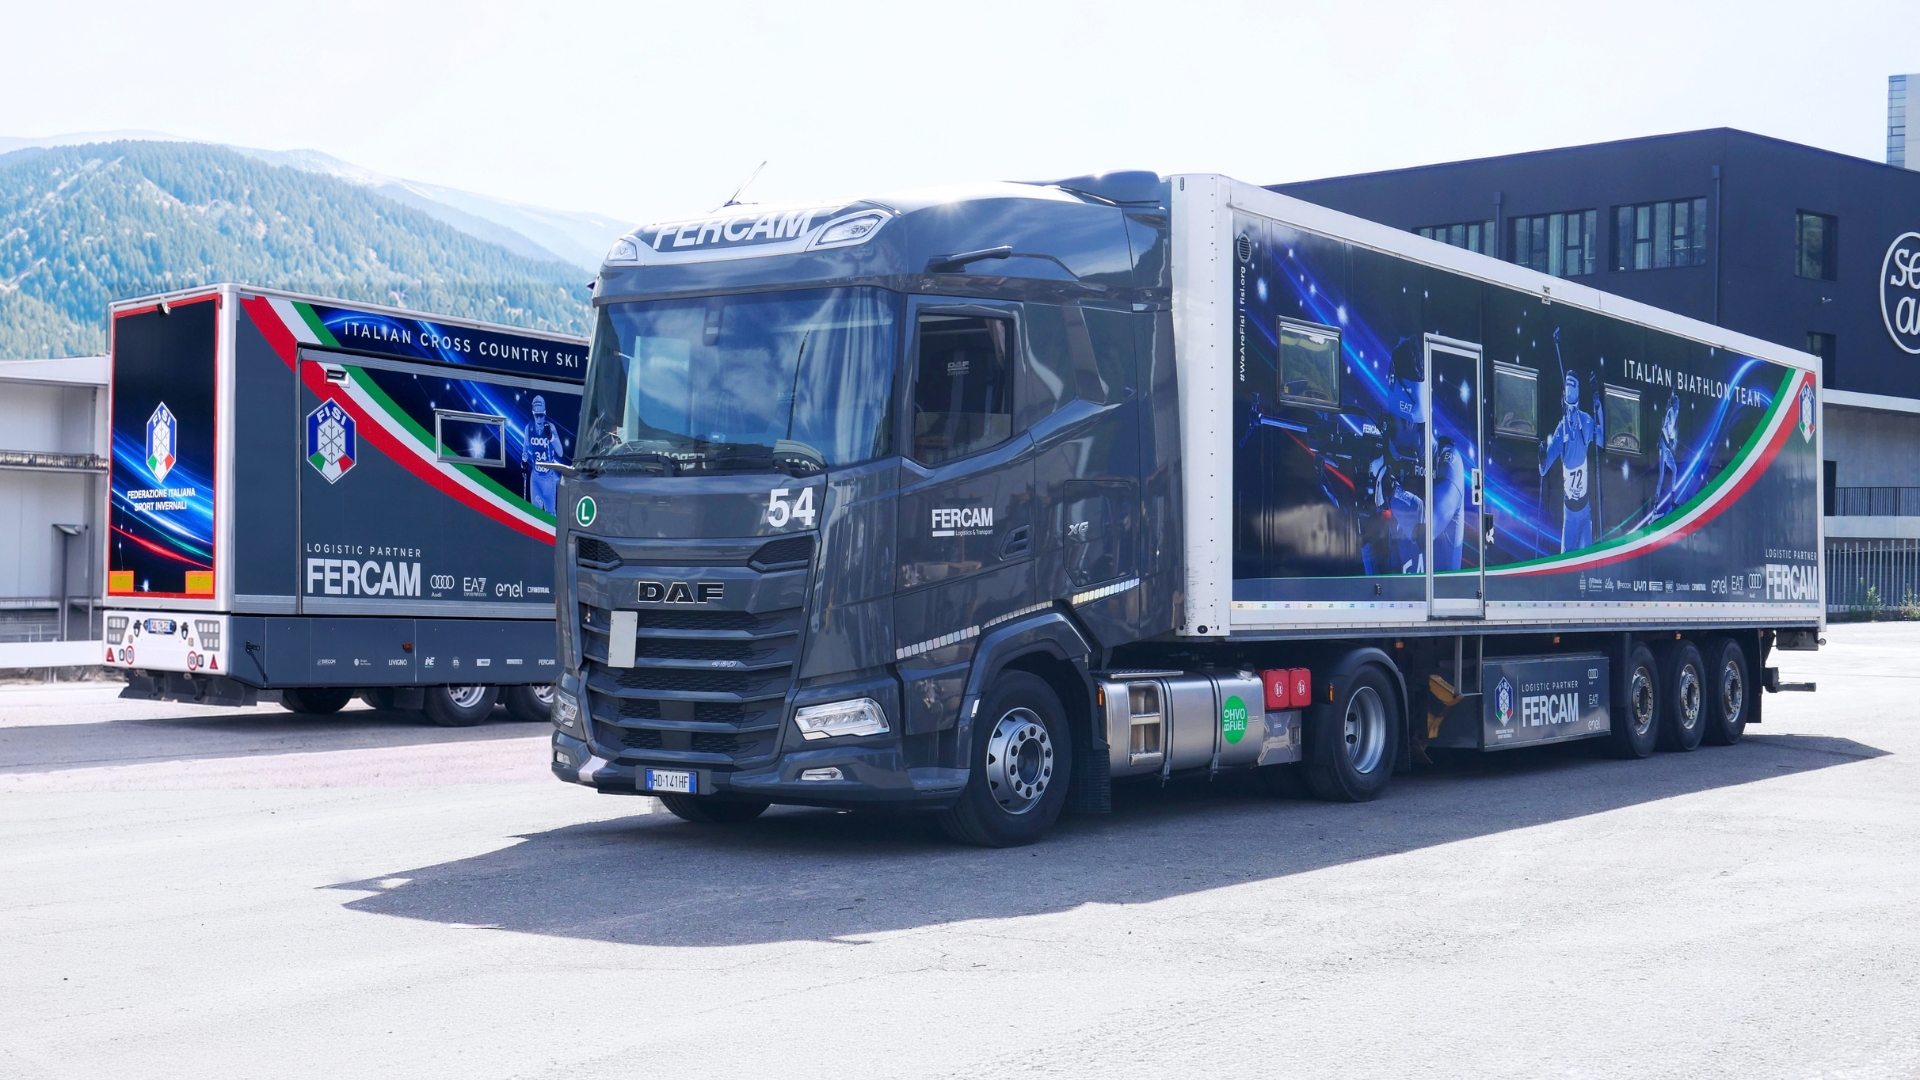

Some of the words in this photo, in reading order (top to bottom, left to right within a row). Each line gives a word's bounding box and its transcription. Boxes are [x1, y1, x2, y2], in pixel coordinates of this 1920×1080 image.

[652, 208, 818, 250] FERCAM
[344, 321, 411, 344] ITALIAN
[420, 332, 471, 353] CROSS
[479, 341, 549, 364] COUNTRY
[556, 352, 578, 368] SKI
[1624, 359, 1672, 388] ITALIAN
[1677, 371, 1731, 400] BIATHLON
[1735, 386, 1761, 408] TEAM
[152, 409, 171, 428] FISI
[316, 406, 347, 426] FISI
[534, 451, 547, 462] 34
[1569, 469, 1583, 489] 72
[127, 489, 168, 499] FEDERAZIONE
[168, 487, 196, 498] ITALIANA
[134, 502, 154, 512] SPORT
[155, 501, 187, 511] INVERNALI
[768, 487, 816, 528] 54
[932, 507, 993, 529] FERCAM
[306, 543, 363, 555] LOGISTIC
[369, 546, 421, 558] PARTNER
[1765, 548, 1791, 559] LOGISTIC
[1793, 550, 1817, 561] PARTNER
[306, 557, 421, 597] FERCAM
[463, 577, 487, 593] EA7
[1711, 575, 1728, 594] enel
[1731, 575, 1744, 591] EA7
[1765, 563, 1818, 600] FERCAM
[495, 580, 524, 598] enel
[637, 581, 725, 604] DAF
[388, 658, 408, 666] LIVIGNO
[1521, 682, 1550, 692] LOGISTIC
[1552, 680, 1579, 689] PARTNER
[1229, 708, 1246, 721] HVO
[1521, 692, 1579, 728] FERCAM
[1229, 720, 1246, 731] FUEL
[1587, 717, 1601, 730] enel
